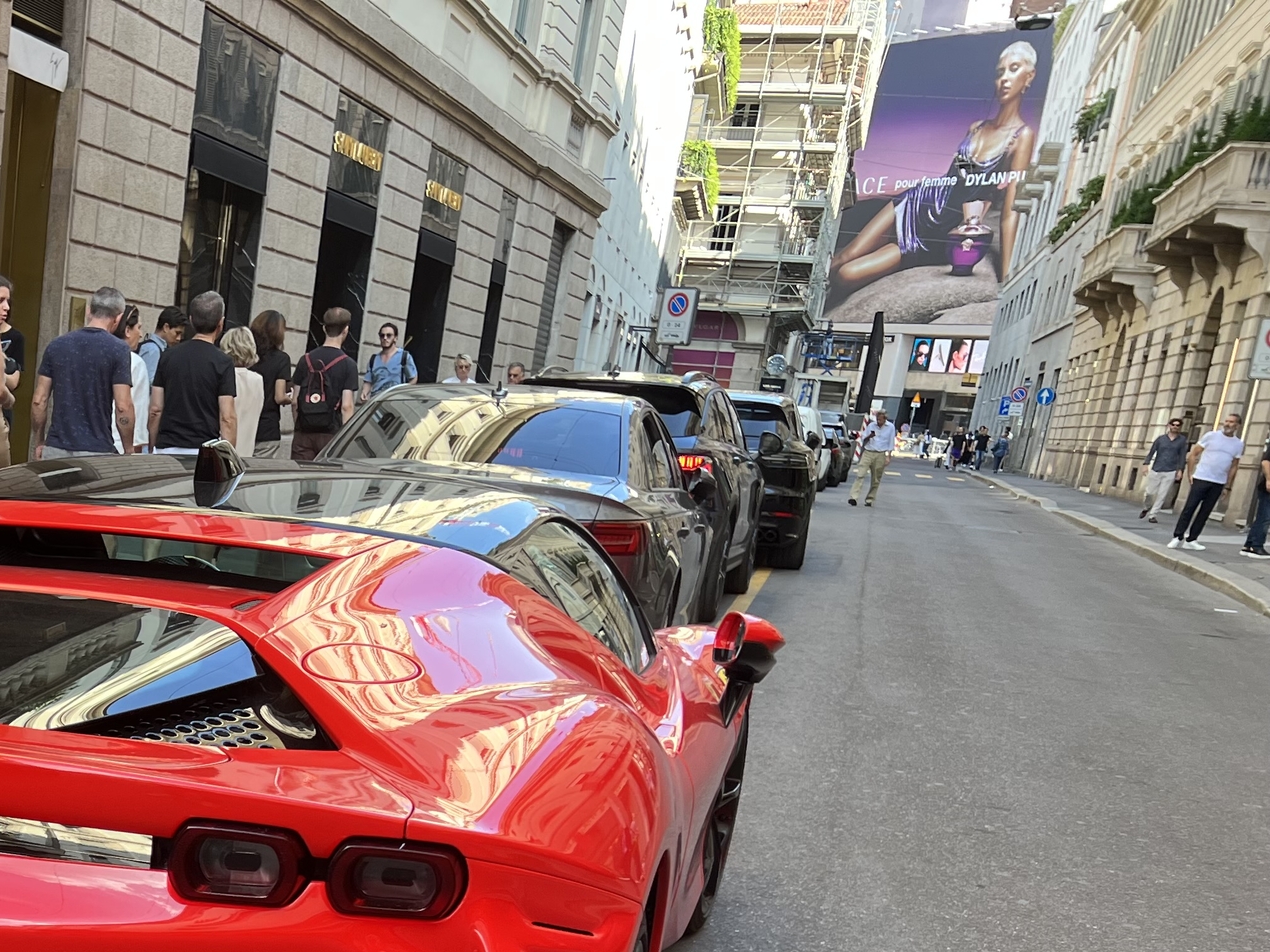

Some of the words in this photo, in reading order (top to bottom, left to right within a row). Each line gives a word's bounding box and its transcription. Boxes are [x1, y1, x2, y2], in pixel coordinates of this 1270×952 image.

[894, 178, 918, 191] pour
[920, 175, 958, 188] femme
[965, 173, 1007, 187] DYLAN
